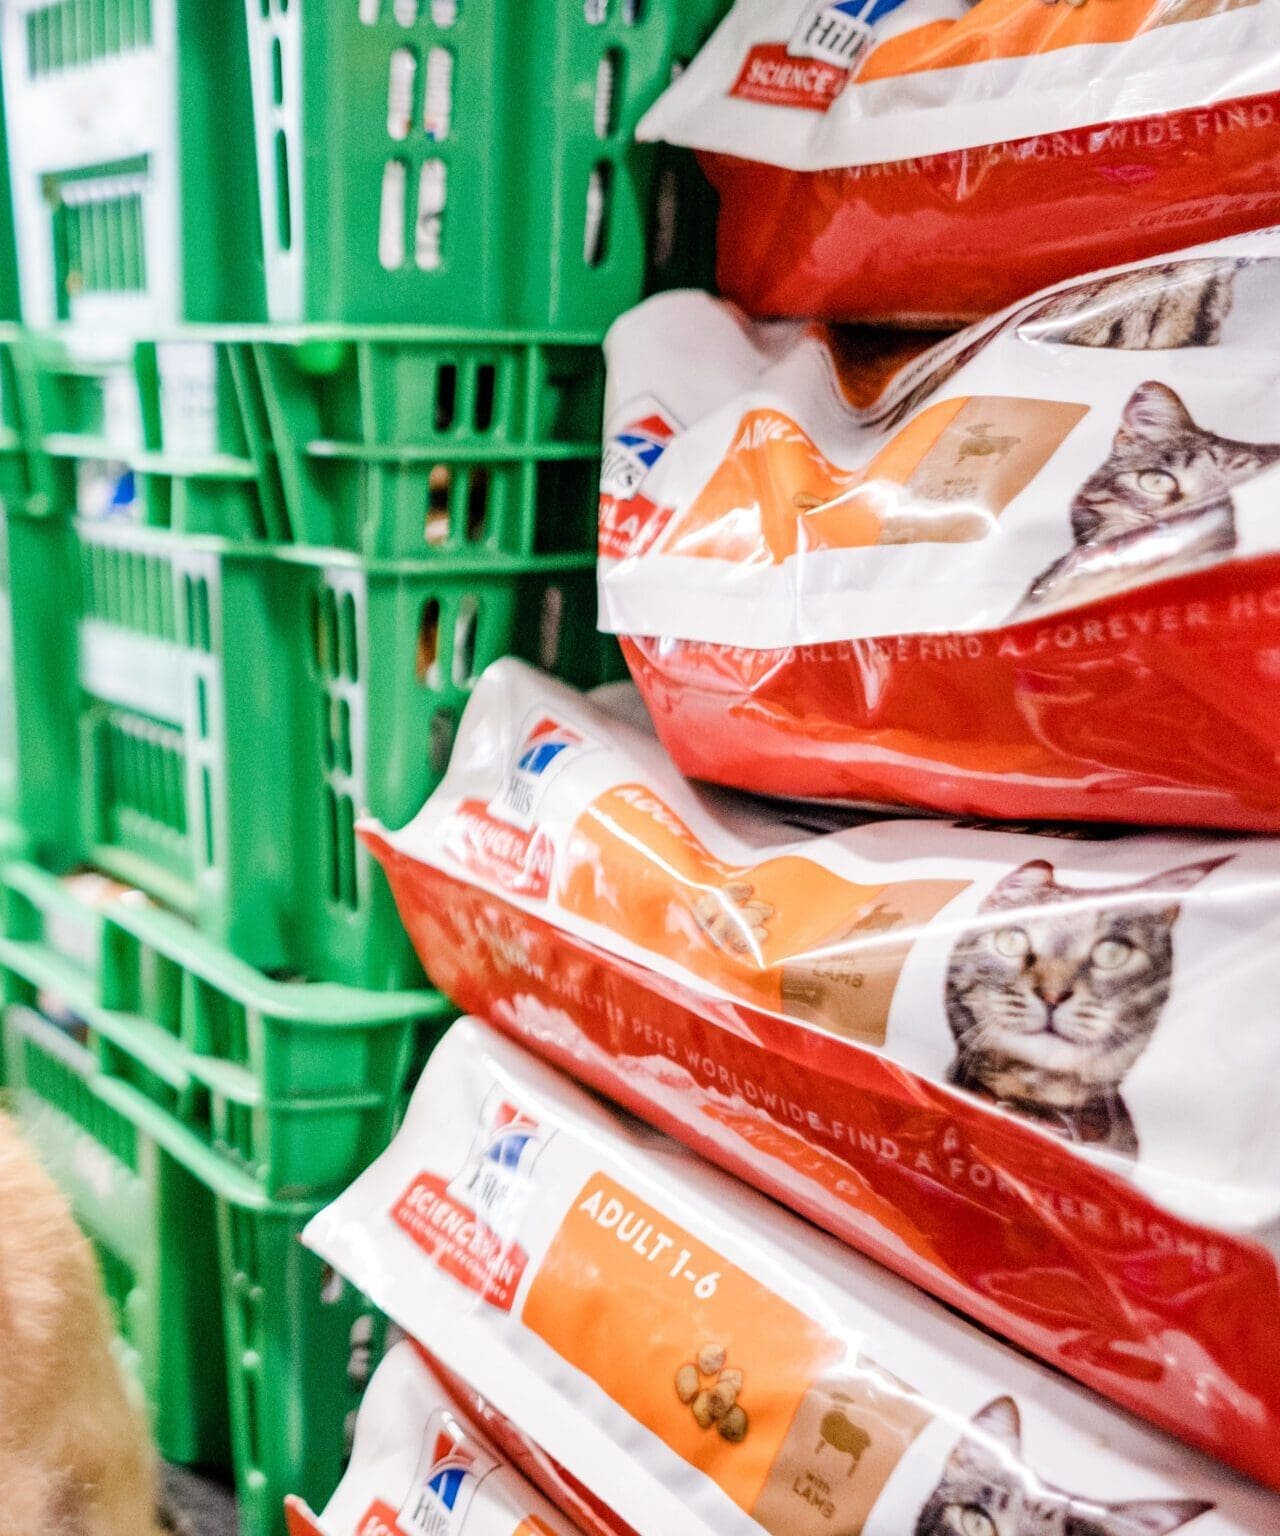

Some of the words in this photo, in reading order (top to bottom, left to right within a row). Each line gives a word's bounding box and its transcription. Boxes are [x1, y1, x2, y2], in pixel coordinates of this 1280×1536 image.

[747, 58, 835, 94] SCIENCE
[1195, 102, 1275, 138] FIND
[920, 637, 983, 661] FIND
[997, 640, 1026, 658] A
[1034, 601, 1209, 652] FOREVER
[631, 1015, 678, 1056] PETS
[684, 1045, 823, 1131] WORLDWIDE
[831, 1120, 901, 1160] FIND
[949, 1156, 1103, 1225] FORVER
[578, 1189, 674, 1262] ADULT
[669, 1248, 722, 1300] 1-6
[792, 1476, 837, 1520] LAMB
